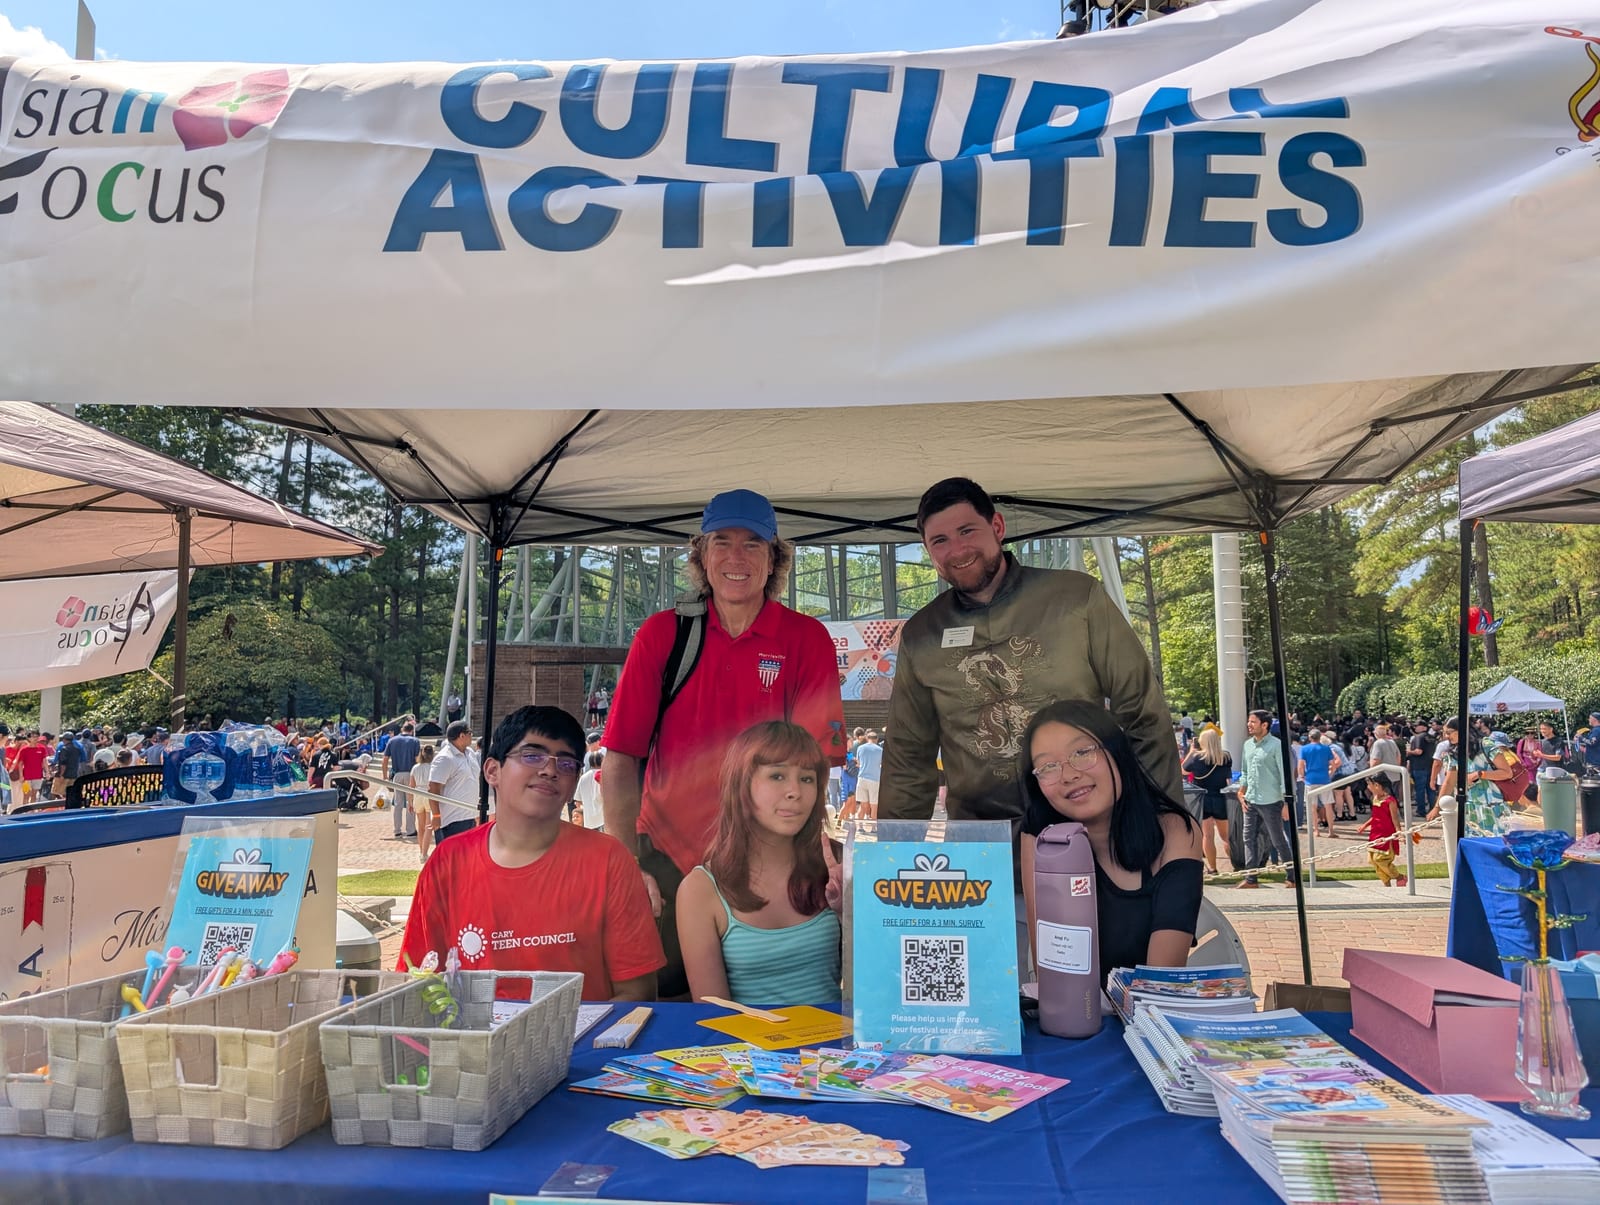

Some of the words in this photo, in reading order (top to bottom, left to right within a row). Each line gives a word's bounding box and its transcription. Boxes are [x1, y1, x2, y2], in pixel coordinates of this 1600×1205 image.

[0, 60, 157, 140] sian
[382, 130, 1368, 253] ACTIVITIES
[197, 871, 289, 897] GIVEAWAY
[874, 879, 991, 906] GIVEAWAY
[195, 906, 208, 914] FREE
[222, 907, 232, 915] FOR
[254, 908, 274, 916] SURVEY
[882, 918, 898, 927] FREE
[899, 918, 916, 927] GIFTS
[917, 919, 930, 927] FOR
[943, 919, 957, 928] MIN.
[958, 919, 984, 928] SURVEY
[491, 930, 514, 939] CARY
[491, 938, 521, 950] TEEN
[522, 932, 577, 947] COUNCIL
[891, 1014, 917, 1022] Please
[917, 1014, 935, 1024] help
[947, 1015, 980, 1025] improve
[889, 1027, 908, 1035] your
[909, 1025, 938, 1034] festival
[939, 1027, 983, 1036] experience
[951, 1065, 1012, 1084] COLORING
[1016, 1080, 1052, 1093] BOOK
[994, 1069, 1031, 1081] TOY
